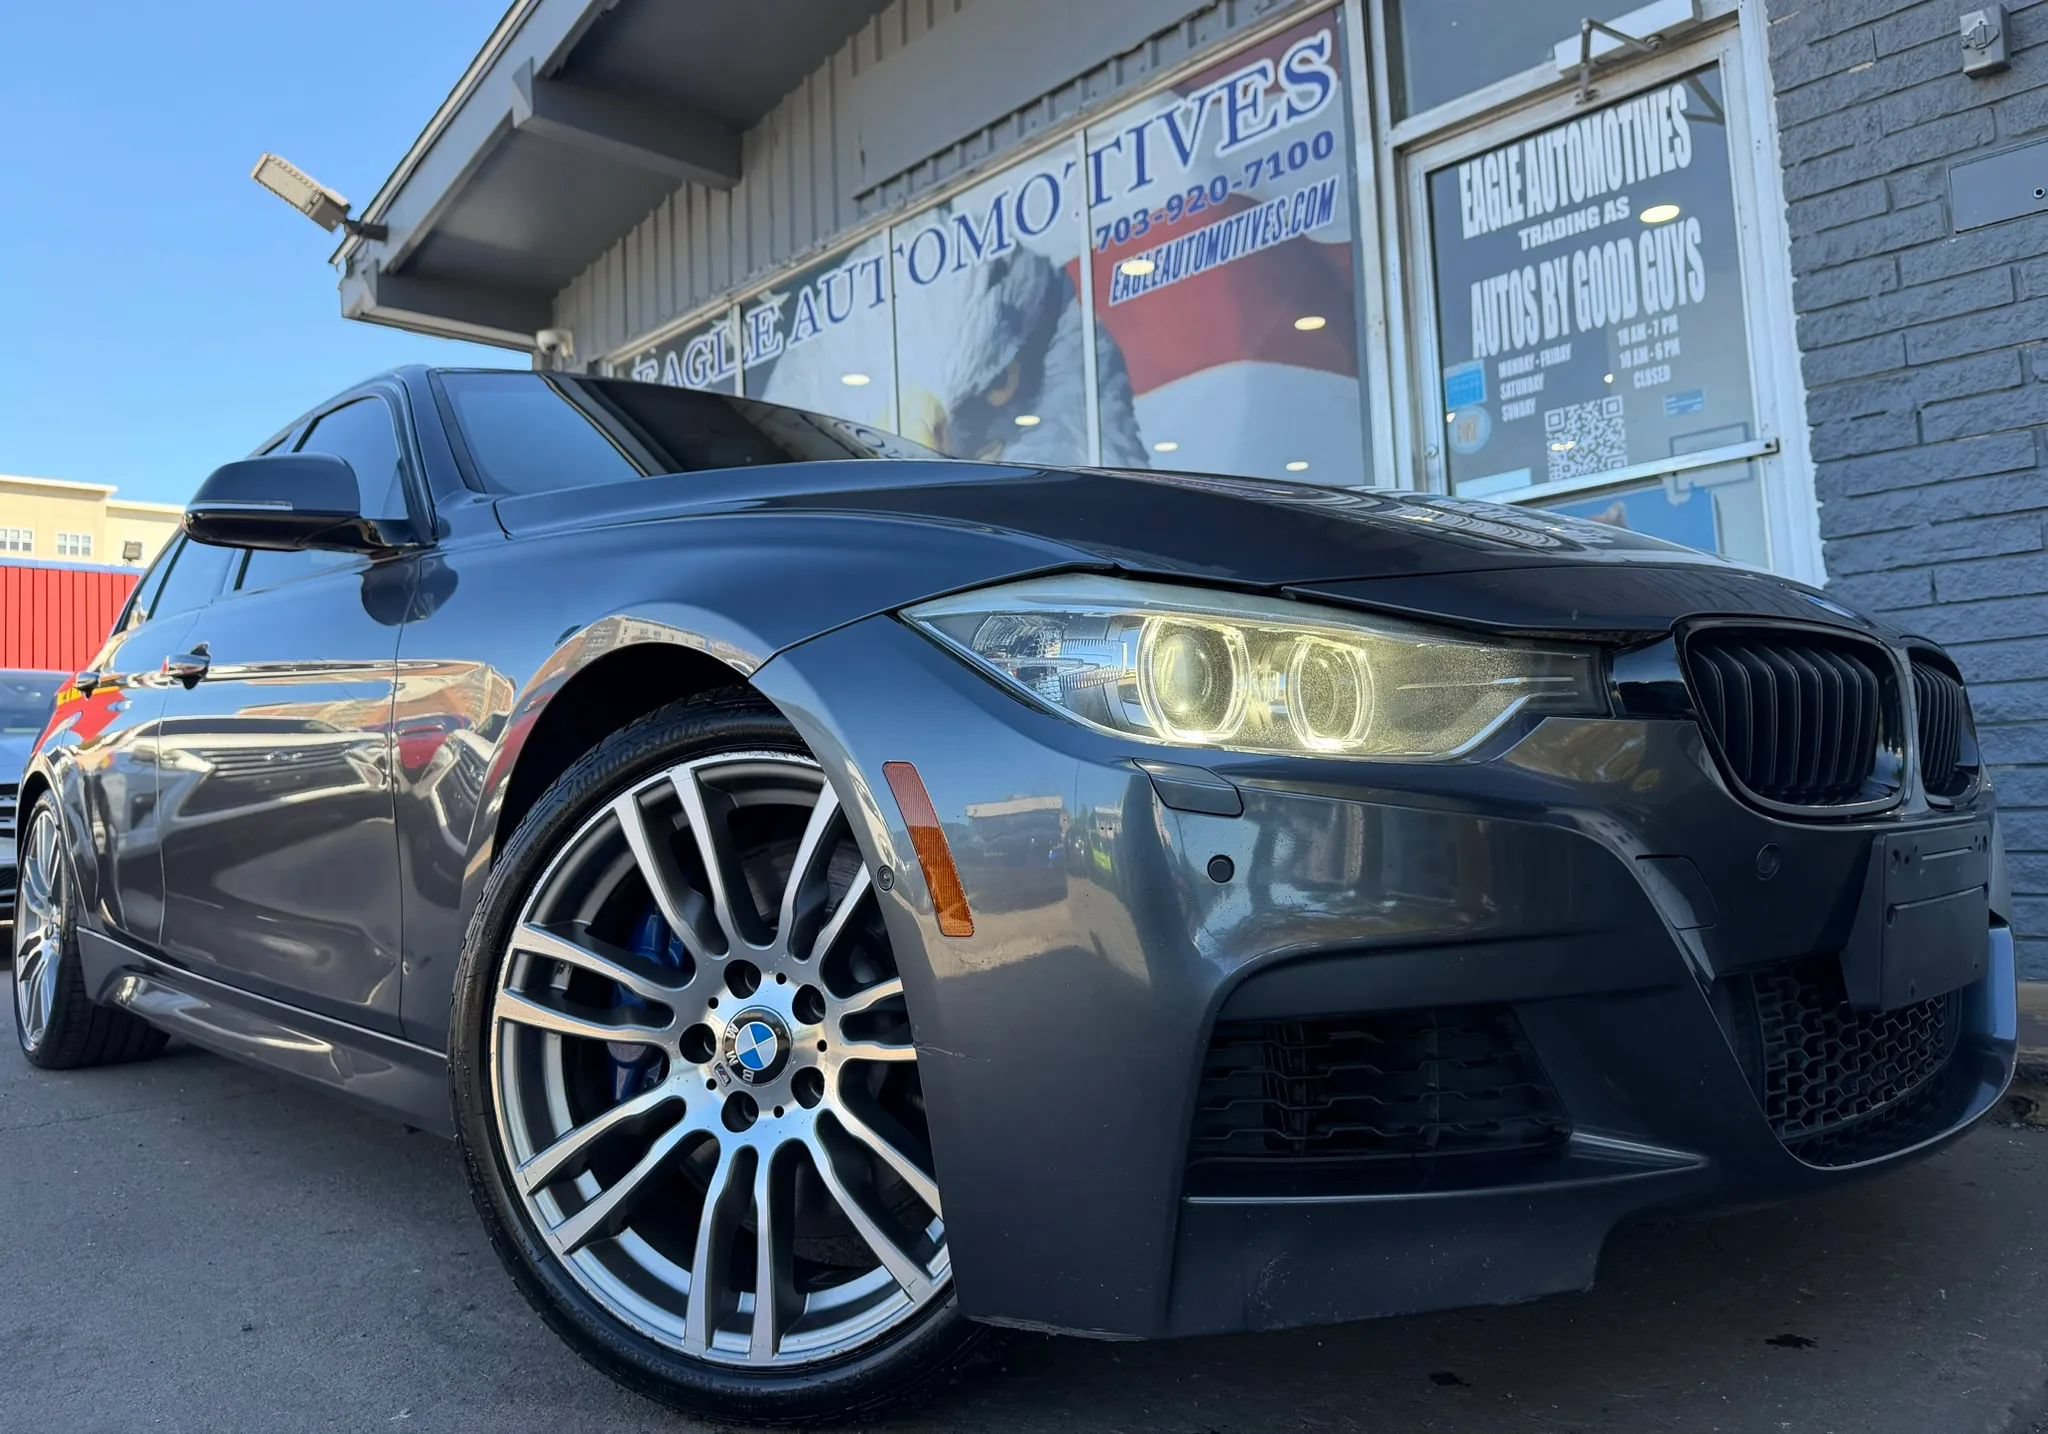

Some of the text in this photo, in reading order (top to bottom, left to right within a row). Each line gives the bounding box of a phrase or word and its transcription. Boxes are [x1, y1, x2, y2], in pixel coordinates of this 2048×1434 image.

[1458, 83, 1692, 240] EAGLE AUTOMOTIVES
[788, 30, 1338, 348] AUTOMOTIVES
[1096, 130, 1335, 252] 703-920-7100
[1110, 177, 1337, 304] EAGLEAUTOMOTIVES.COM
[1518, 195, 1631, 251] TRADING AS
[1470, 216, 1706, 359] AUTOS BY GOOD GUYS
[1661, 313, 1679, 335] PM
[1498, 352, 1535, 379] MONDAY
[1540, 342, 1572, 368] FRIDAY
[1663, 337, 1680, 358] PM
[1500, 372, 1544, 400] SATURDAY
[1633, 364, 1671, 389] CLOSED
[1501, 397, 1536, 421] SUNDAY
